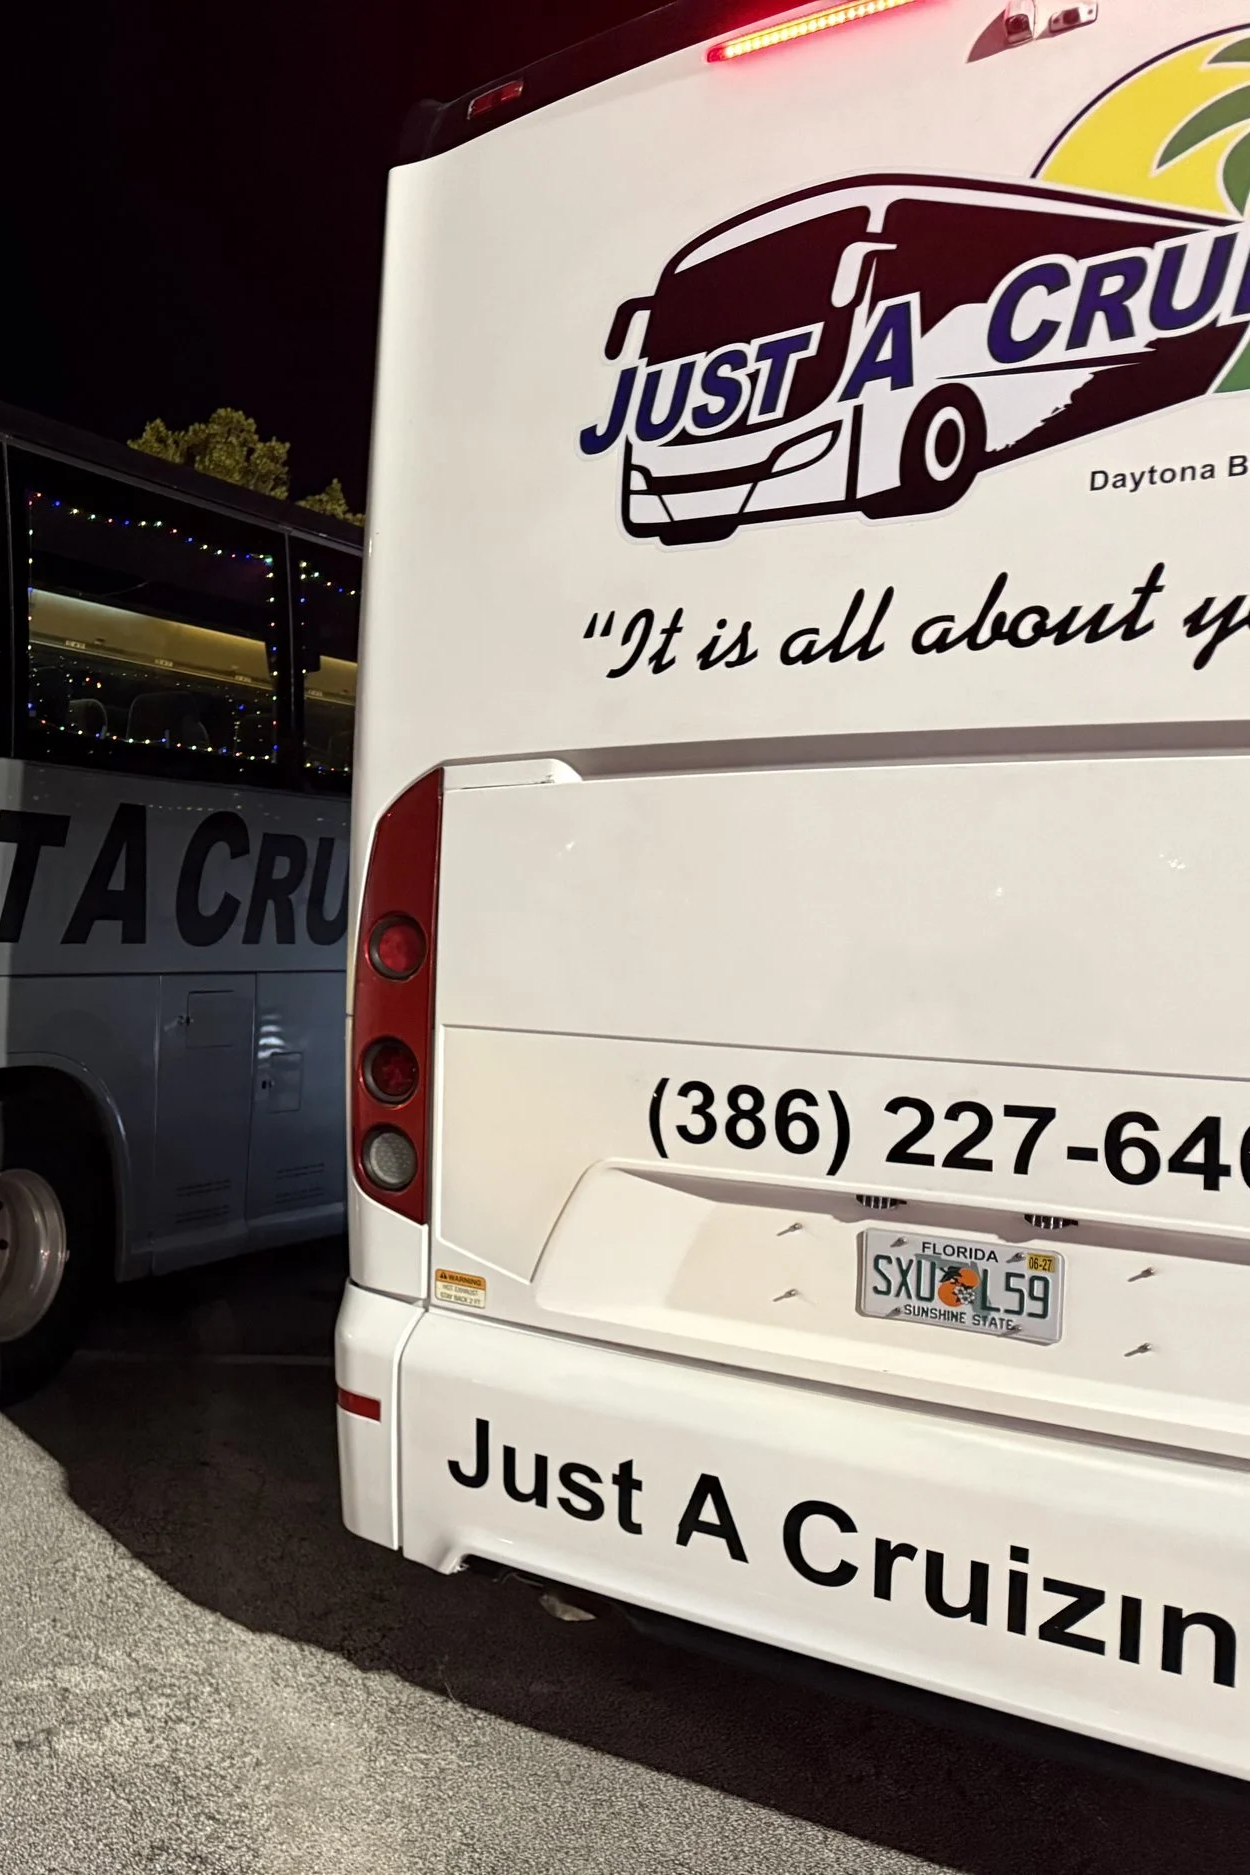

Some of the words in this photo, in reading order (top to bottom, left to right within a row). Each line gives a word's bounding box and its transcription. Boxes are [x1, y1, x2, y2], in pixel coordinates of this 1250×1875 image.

[579, 331, 814, 455] JUST
[837, 300, 914, 402] A
[1089, 462, 1215, 493] Daytona
[696, 617, 758, 671] is
[779, 585, 895, 666] all
[911, 562, 1165, 655] about
[1183, 594, 1250, 671] y
[60, 803, 146, 945] A
[649, 1077, 851, 1177] (386)
[884, 1096, 1250, 1192] 227-64
[872, 1253, 937, 1304] SXU
[980, 1268, 1050, 1320] L59
[921, 1241, 999, 1263] FLORIDA
[1028, 1255, 1053, 1273] 06-27
[903, 1303, 966, 1325] SUNSHINE
[972, 1314, 1014, 1331] STATE
[447, 1417, 643, 1535] Just
[675, 1473, 749, 1564] A
